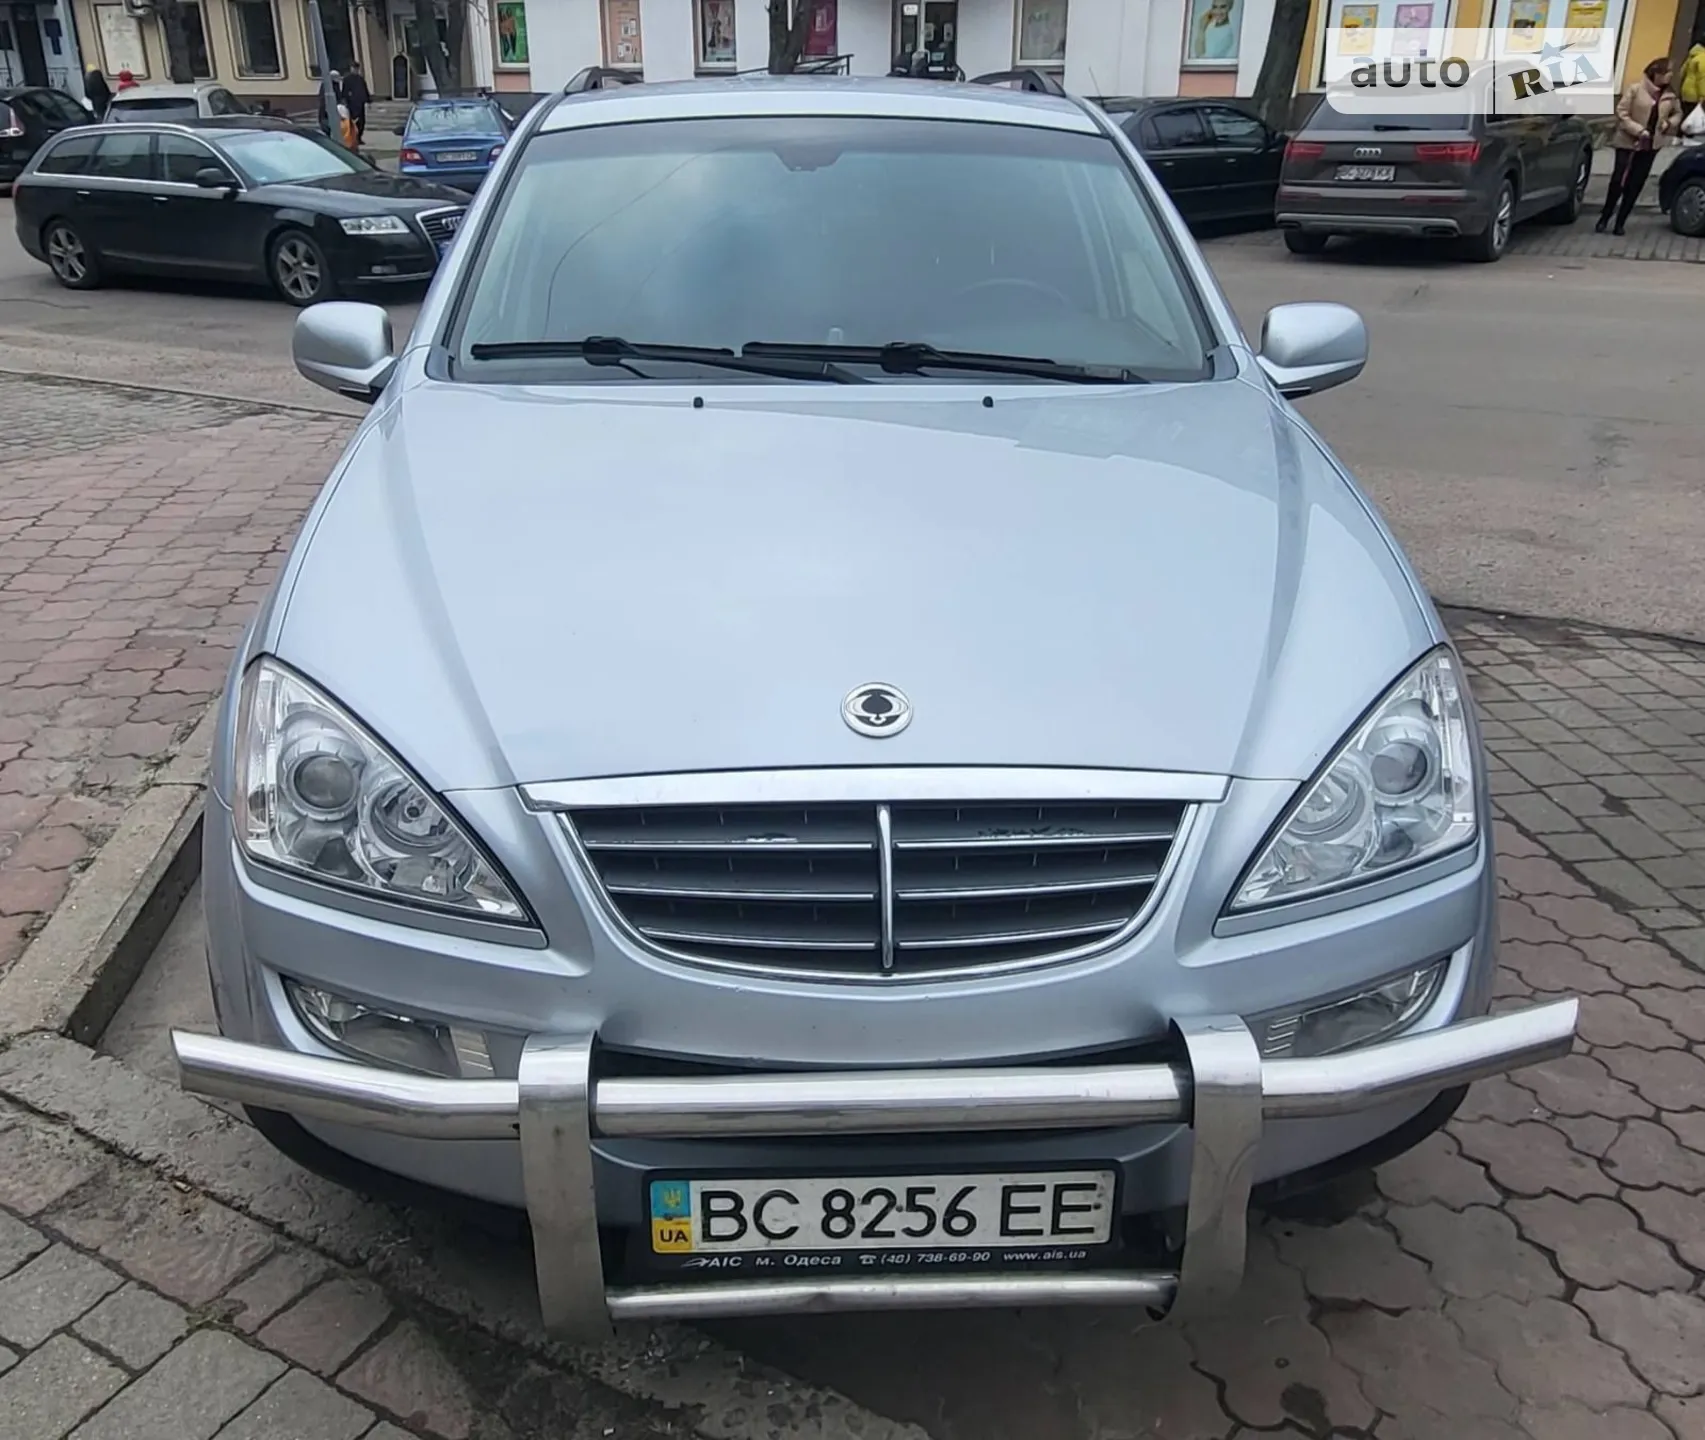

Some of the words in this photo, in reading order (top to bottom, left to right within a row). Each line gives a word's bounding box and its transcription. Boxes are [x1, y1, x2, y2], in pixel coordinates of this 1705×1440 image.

[700, 1189, 800, 1243] BC
[820, 1185, 978, 1240] 8256
[998, 1183, 1098, 1238] EE
[660, 1229, 688, 1243] UA
[784, 1253, 842, 1267] Одеса
[917, 1251, 991, 1264] 738-69-90
[1003, 1249, 1087, 1262] www.ais.ua
